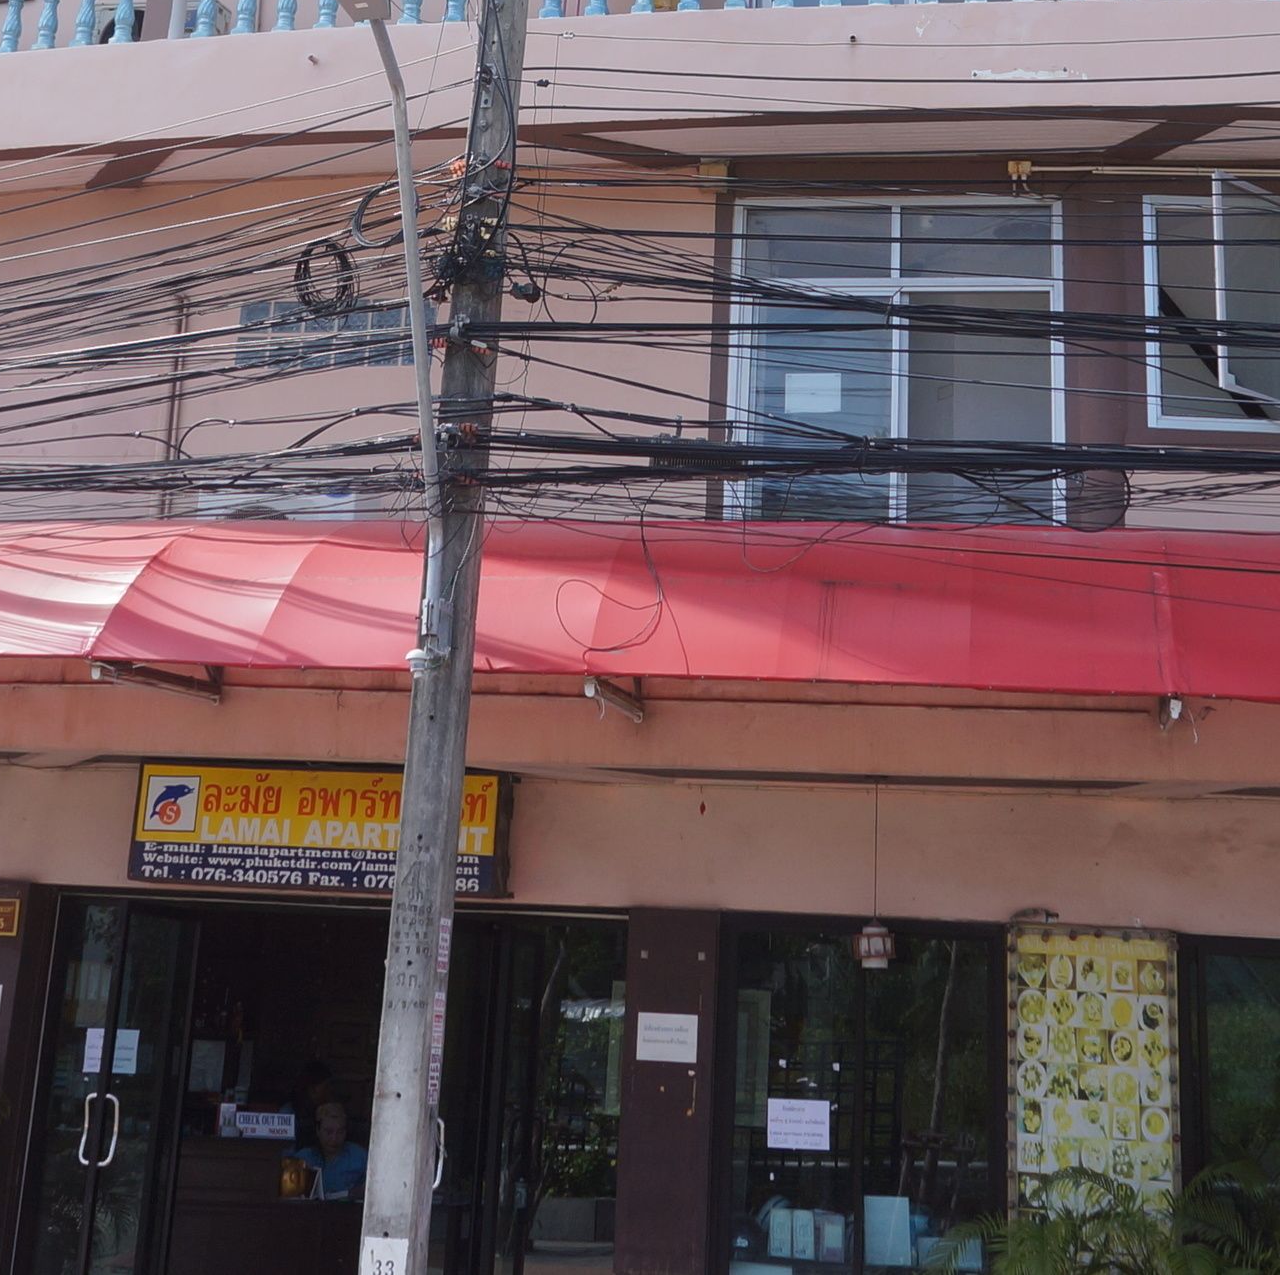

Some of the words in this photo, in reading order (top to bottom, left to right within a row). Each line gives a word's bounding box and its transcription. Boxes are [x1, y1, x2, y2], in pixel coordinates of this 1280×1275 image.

[203, 773, 282, 815] ละมัย
[200, 815, 291, 845] LAMAI
[144, 842, 206, 854] E-mail:
[142, 852, 203, 865] Website:
[141, 864, 173, 879] Tel.
[190, 866, 303, 885] 076-340576
[307, 871, 345, 887] Fax.
[261, 1115, 275, 1126] OUT
